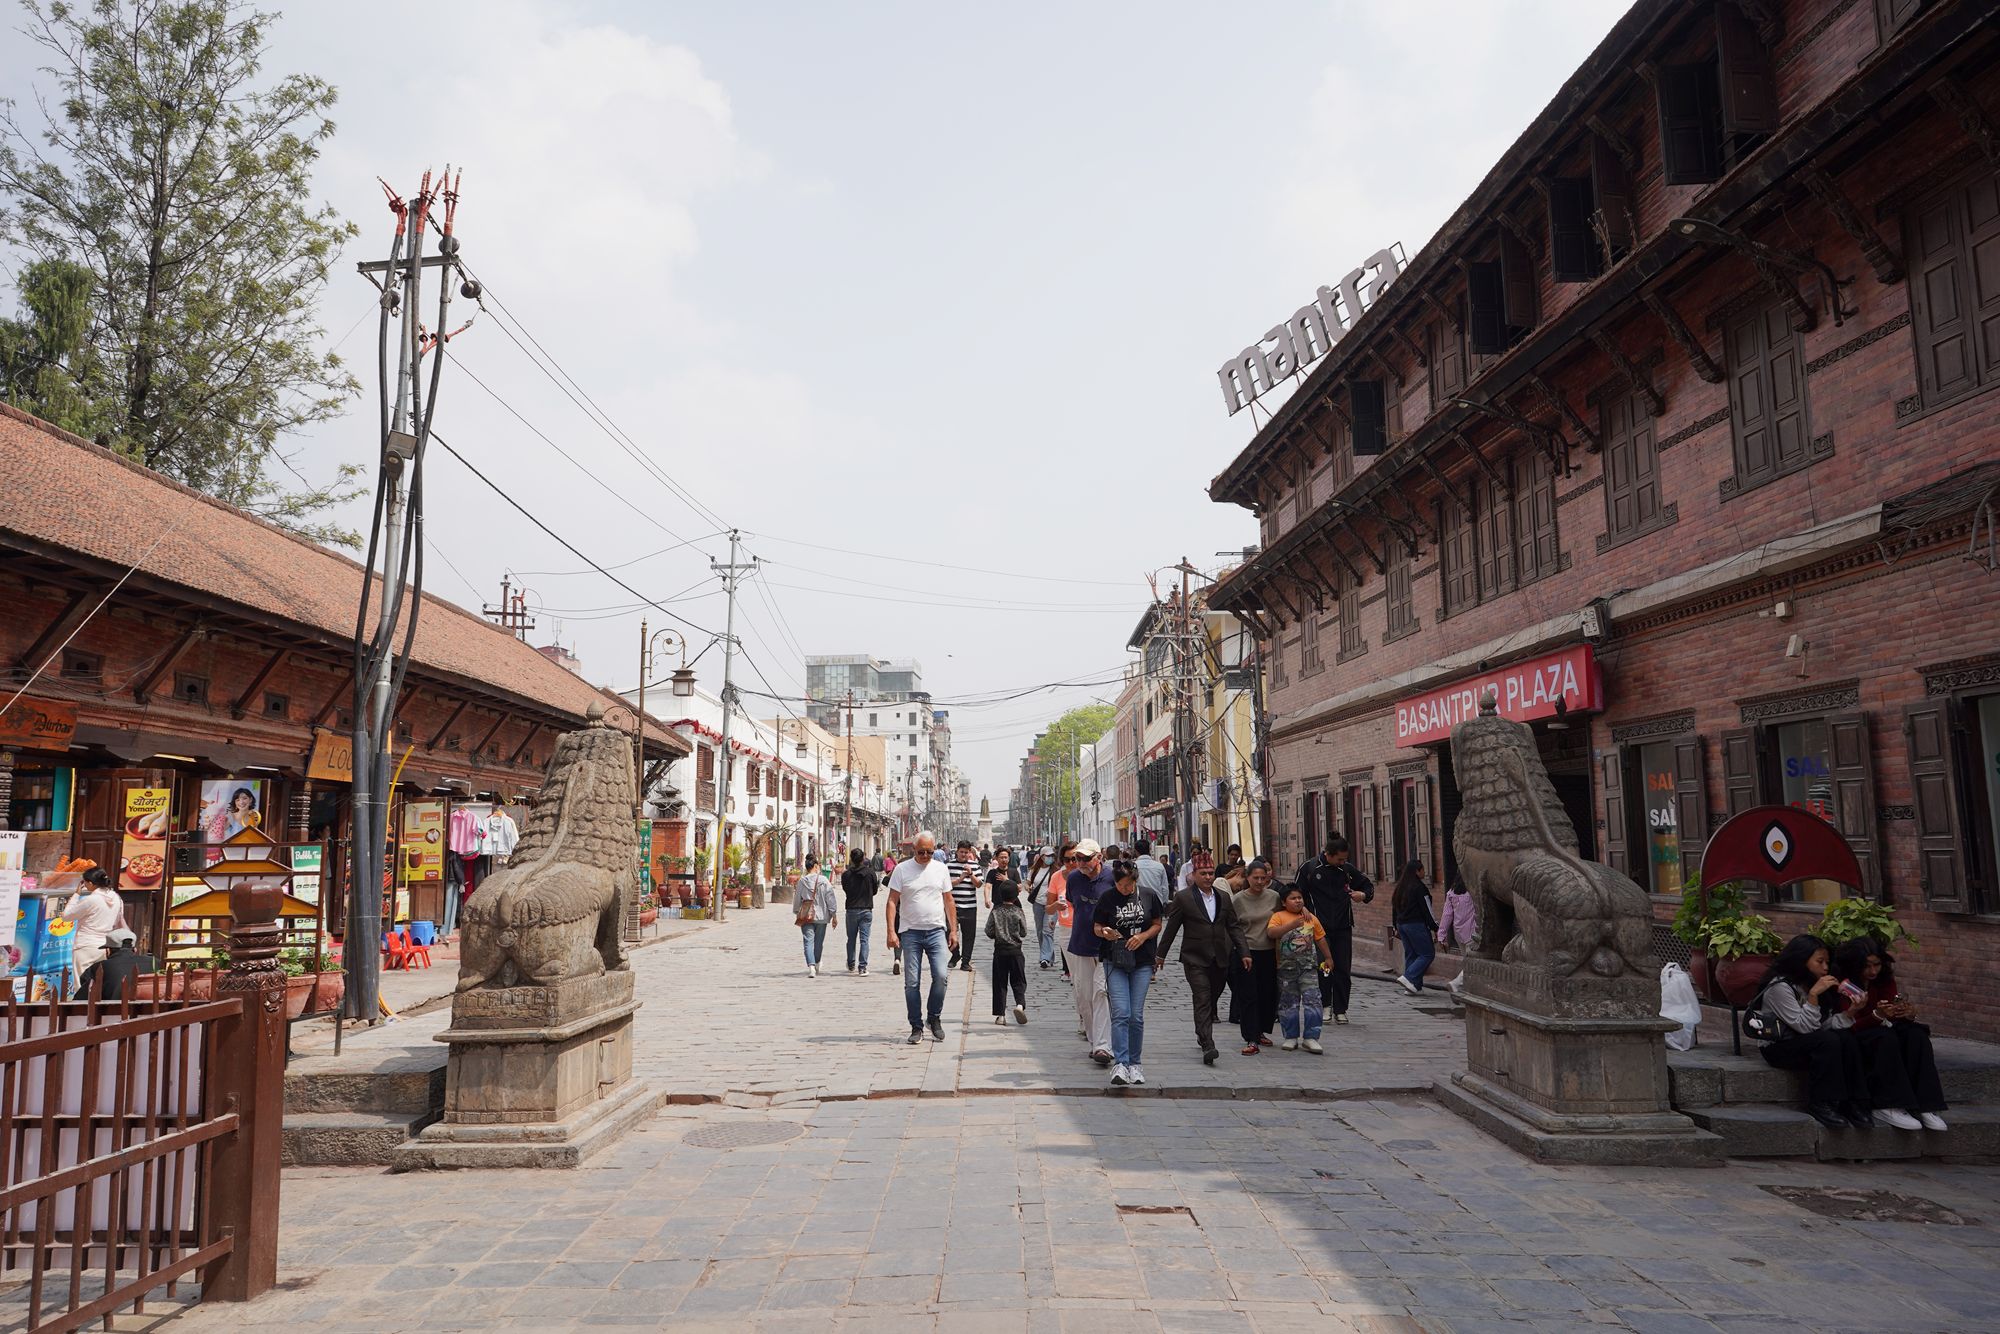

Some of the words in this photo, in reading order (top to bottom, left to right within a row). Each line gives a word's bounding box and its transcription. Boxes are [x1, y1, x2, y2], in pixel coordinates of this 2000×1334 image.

[1218, 248, 1401, 413] mantra
[1506, 661, 1580, 712] PLAZA
[33, 712, 73, 733] Durbar
[128, 805, 157, 813] Yomari
[132, 796, 167, 808] योमरी
[1791, 800, 1834, 820] AL
[1650, 808, 1677, 827] SAL
[294, 850, 313, 861] Bubble
